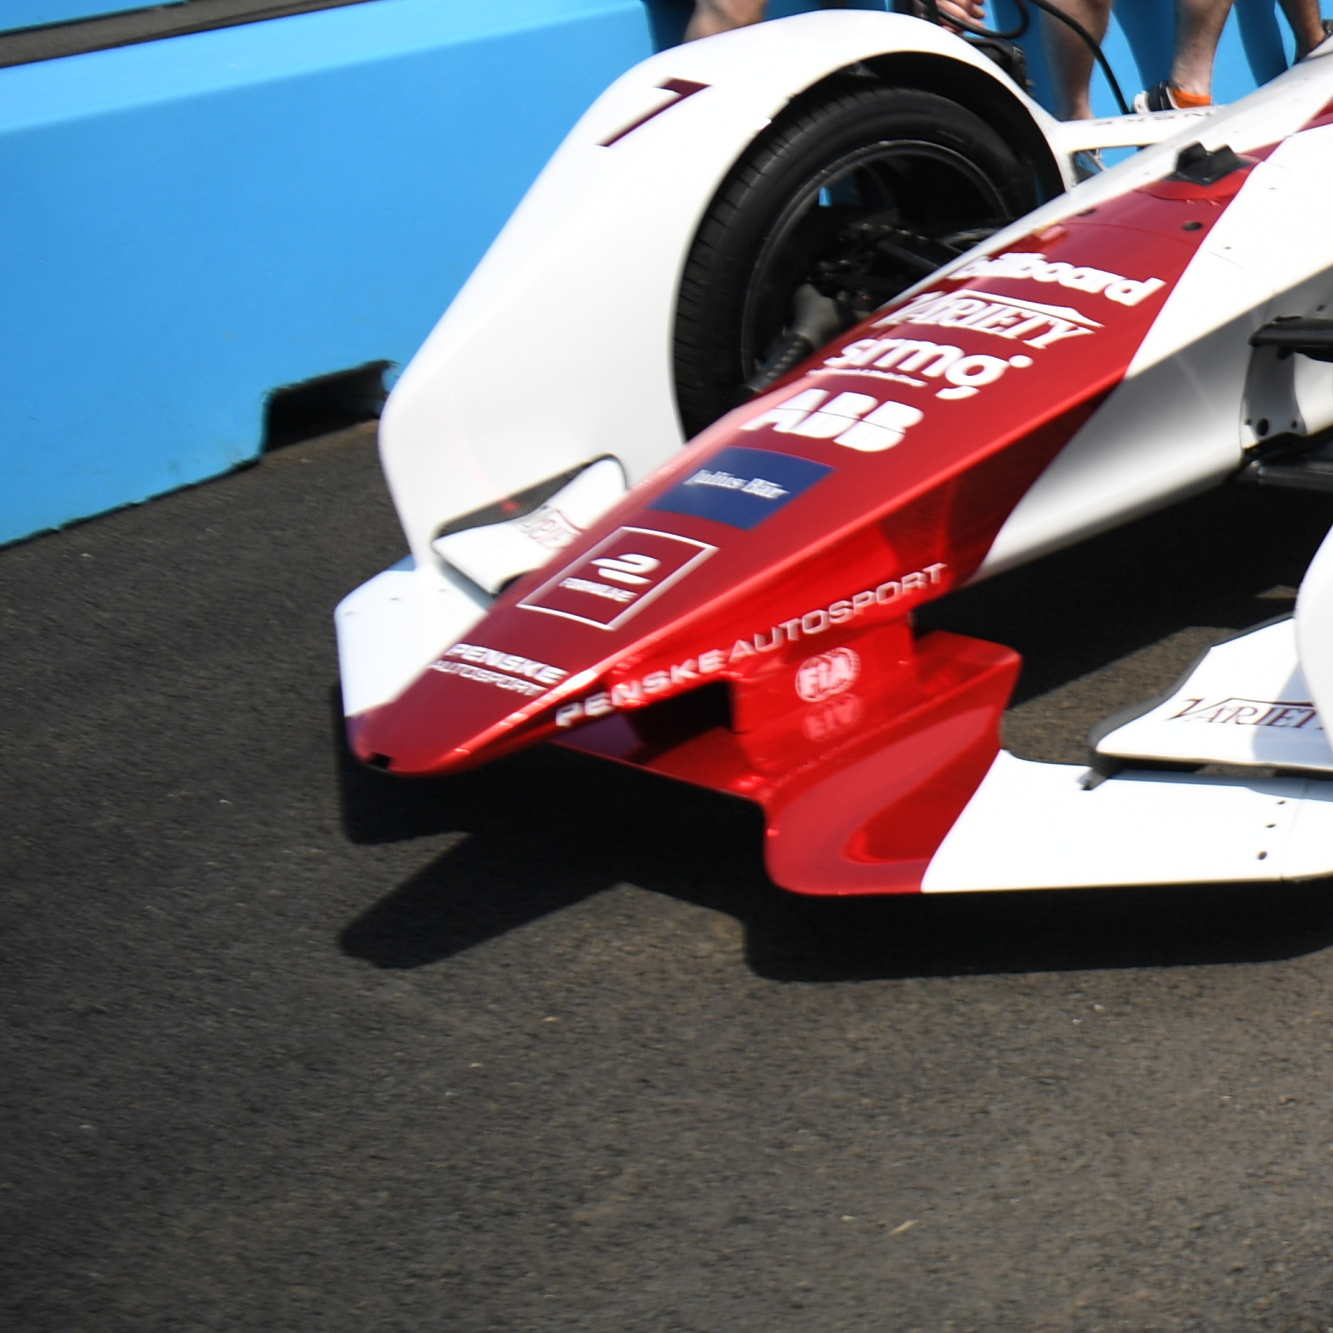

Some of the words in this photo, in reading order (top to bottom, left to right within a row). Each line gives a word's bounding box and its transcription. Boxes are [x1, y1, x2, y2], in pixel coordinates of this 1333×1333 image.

[594, 77, 713, 148] 7
[870, 289, 1105, 350] VARIETY
[823, 338, 1034, 401] srmg
[738, 388, 925, 453] ABB
[728, 562, 949, 664] AUTOSPORT
[444, 642, 571, 685] PENSKE
[555, 648, 729, 728] PENSKE
[799, 655, 853, 697] FIA
[1165, 697, 1324, 731] VARIET
